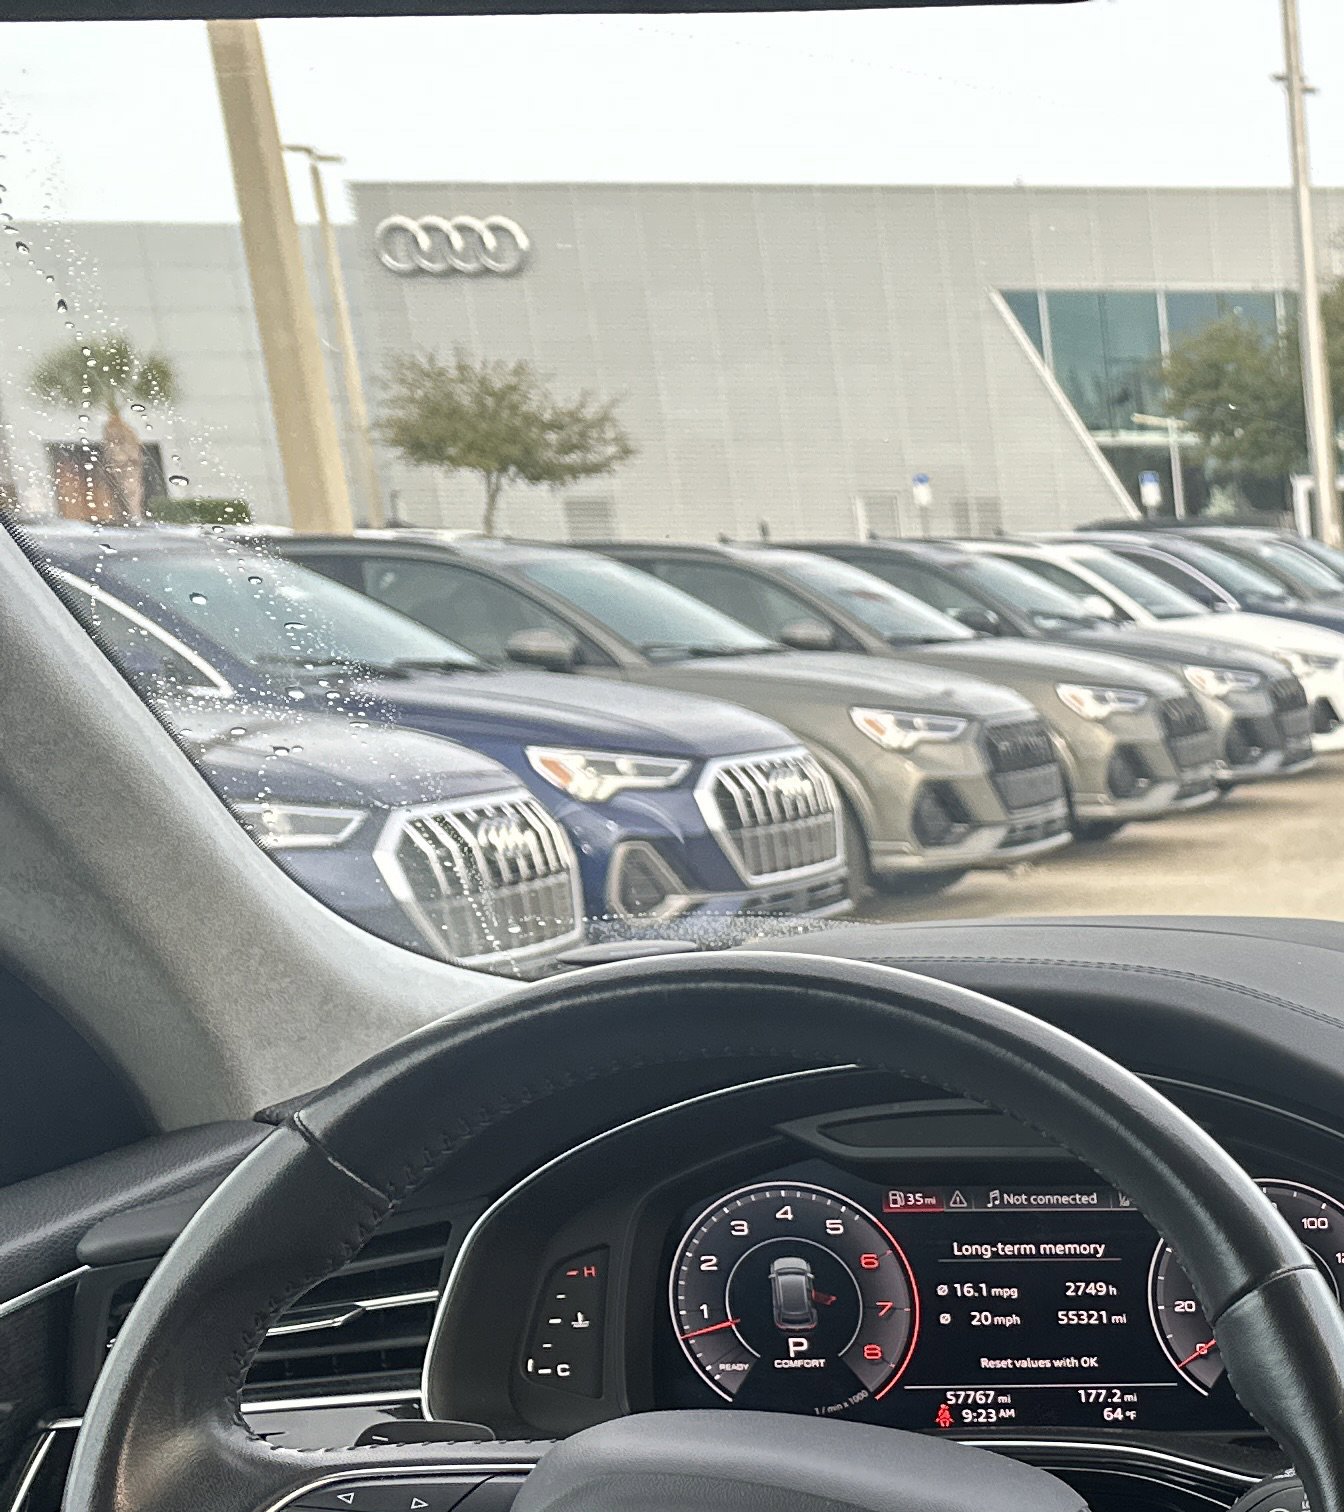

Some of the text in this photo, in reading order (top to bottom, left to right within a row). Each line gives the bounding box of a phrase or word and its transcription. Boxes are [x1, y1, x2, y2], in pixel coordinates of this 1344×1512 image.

[1003, 1193, 1098, 1205] Not connected
[775, 1205, 793, 1221] 4
[730, 1220, 748, 1235] 3
[825, 1219, 844, 1235] 5
[1301, 1217, 1329, 1230] 100
[952, 1242, 1106, 1258] Long-term memory
[700, 1255, 718, 1271] 2
[860, 1253, 879, 1269] 6
[583, 1266, 597, 1277] H
[953, 1283, 1019, 1299] 16.1 mpg
[1065, 1282, 1107, 1296] 2749
[700, 1303, 708, 1319] 1
[876, 1301, 894, 1317] 7
[1174, 1301, 1196, 1312] 20
[970, 1311, 1021, 1328] 20 mph
[1057, 1310, 1127, 1325] 55321 mi
[788, 1337, 808, 1357] P
[863, 1344, 882, 1360] 8
[719, 1363, 749, 1371] READY
[774, 1359, 825, 1369] COMFORT
[980, 1356, 1098, 1369] Reset values with OK
[556, 1364, 571, 1377] C
[849, 1390, 868, 1406] 1000
[946, 1391, 1012, 1405] 57767 mi
[1077, 1389, 1137, 1403] 177.2 mi
[961, 1409, 1015, 1423] 9:23 AM
[1103, 1408, 1123, 1421] 64
